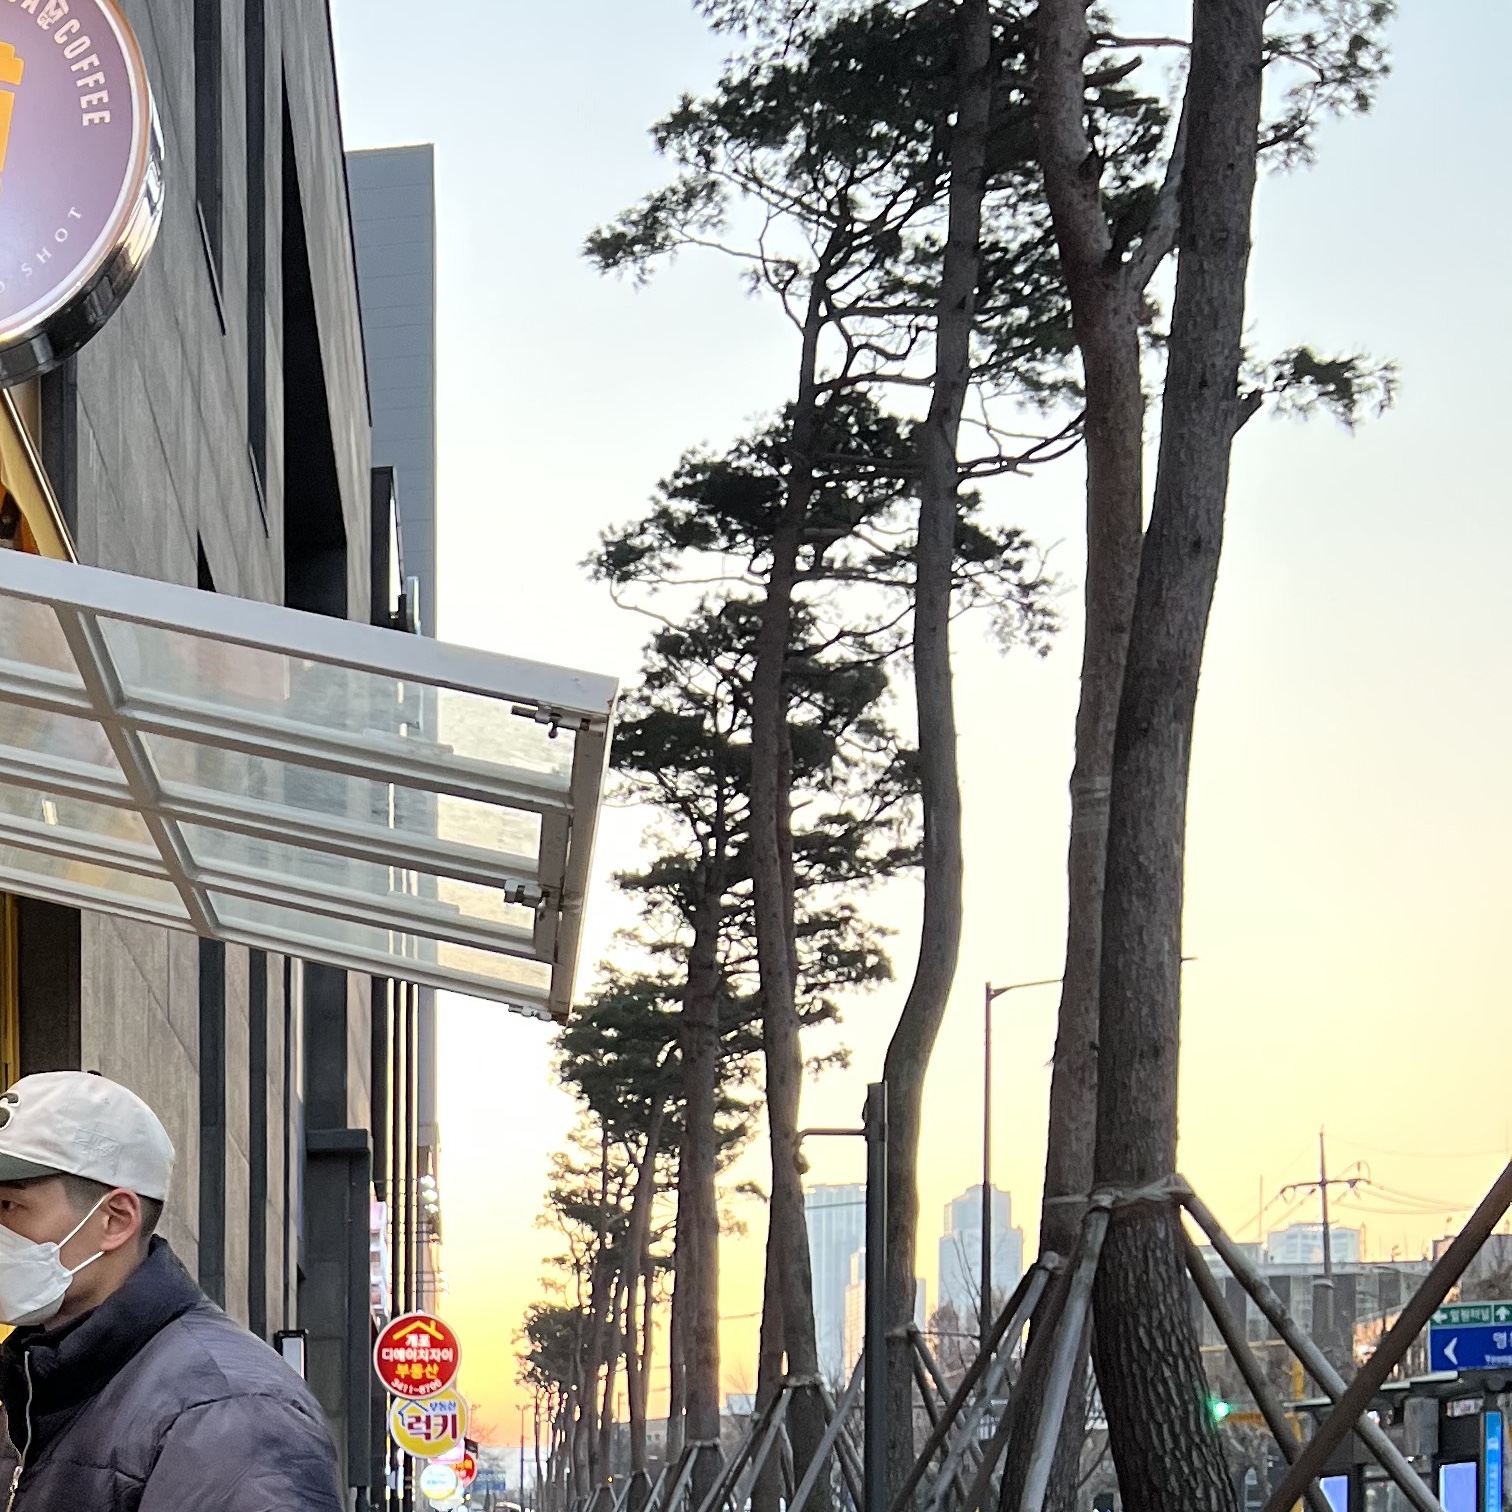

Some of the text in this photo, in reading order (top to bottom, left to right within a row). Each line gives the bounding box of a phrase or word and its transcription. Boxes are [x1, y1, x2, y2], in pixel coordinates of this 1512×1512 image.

[53, 18, 110, 126] COFFEE
[20, 206, 82, 277] SHOT
[405, 1333, 431, 1348] 개포
[381, 1347, 454, 1363] 디에이치자이
[395, 1363, 440, 1380] 부동산
[406, 1413, 458, 1441] 럭키
